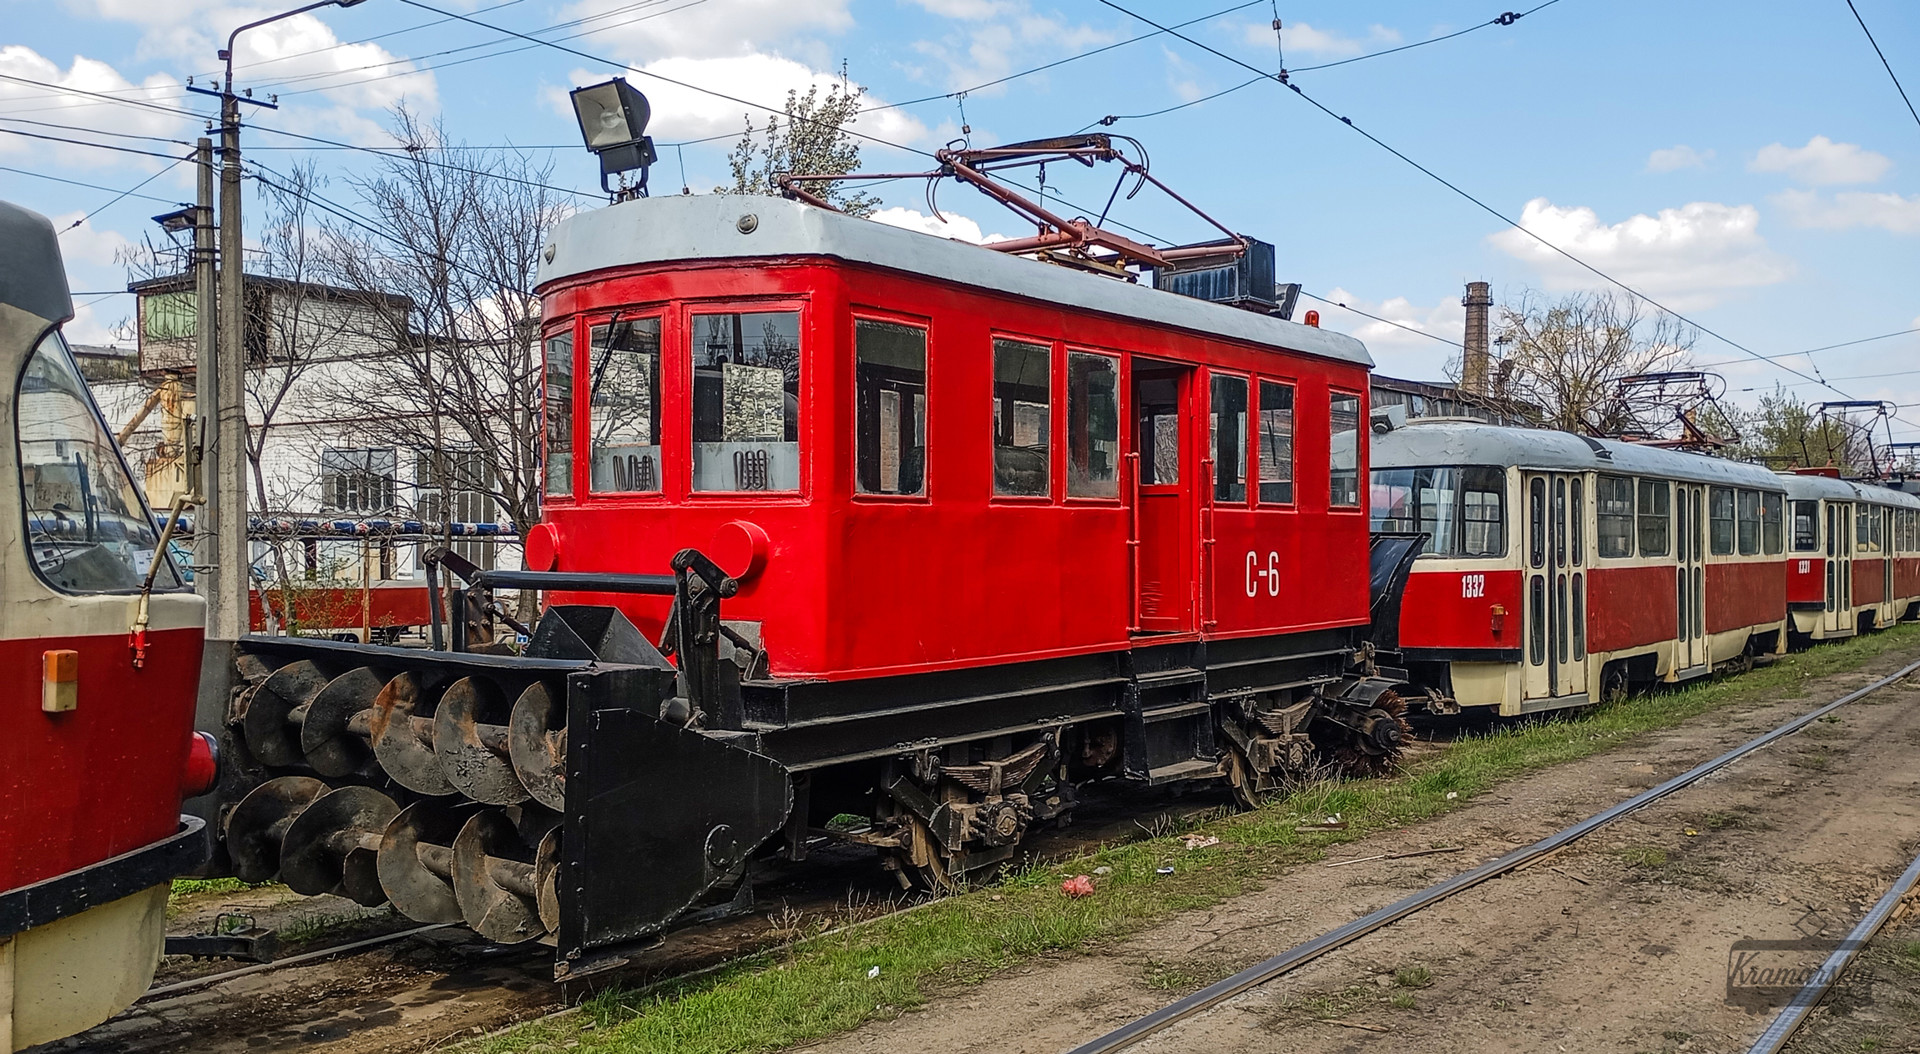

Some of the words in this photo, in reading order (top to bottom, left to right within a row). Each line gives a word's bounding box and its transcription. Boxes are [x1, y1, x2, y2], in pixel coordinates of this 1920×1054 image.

[1246, 550, 1280, 598] С-6
[1798, 559, 1810, 574] 1331
[1461, 574, 1485, 598] 1332
